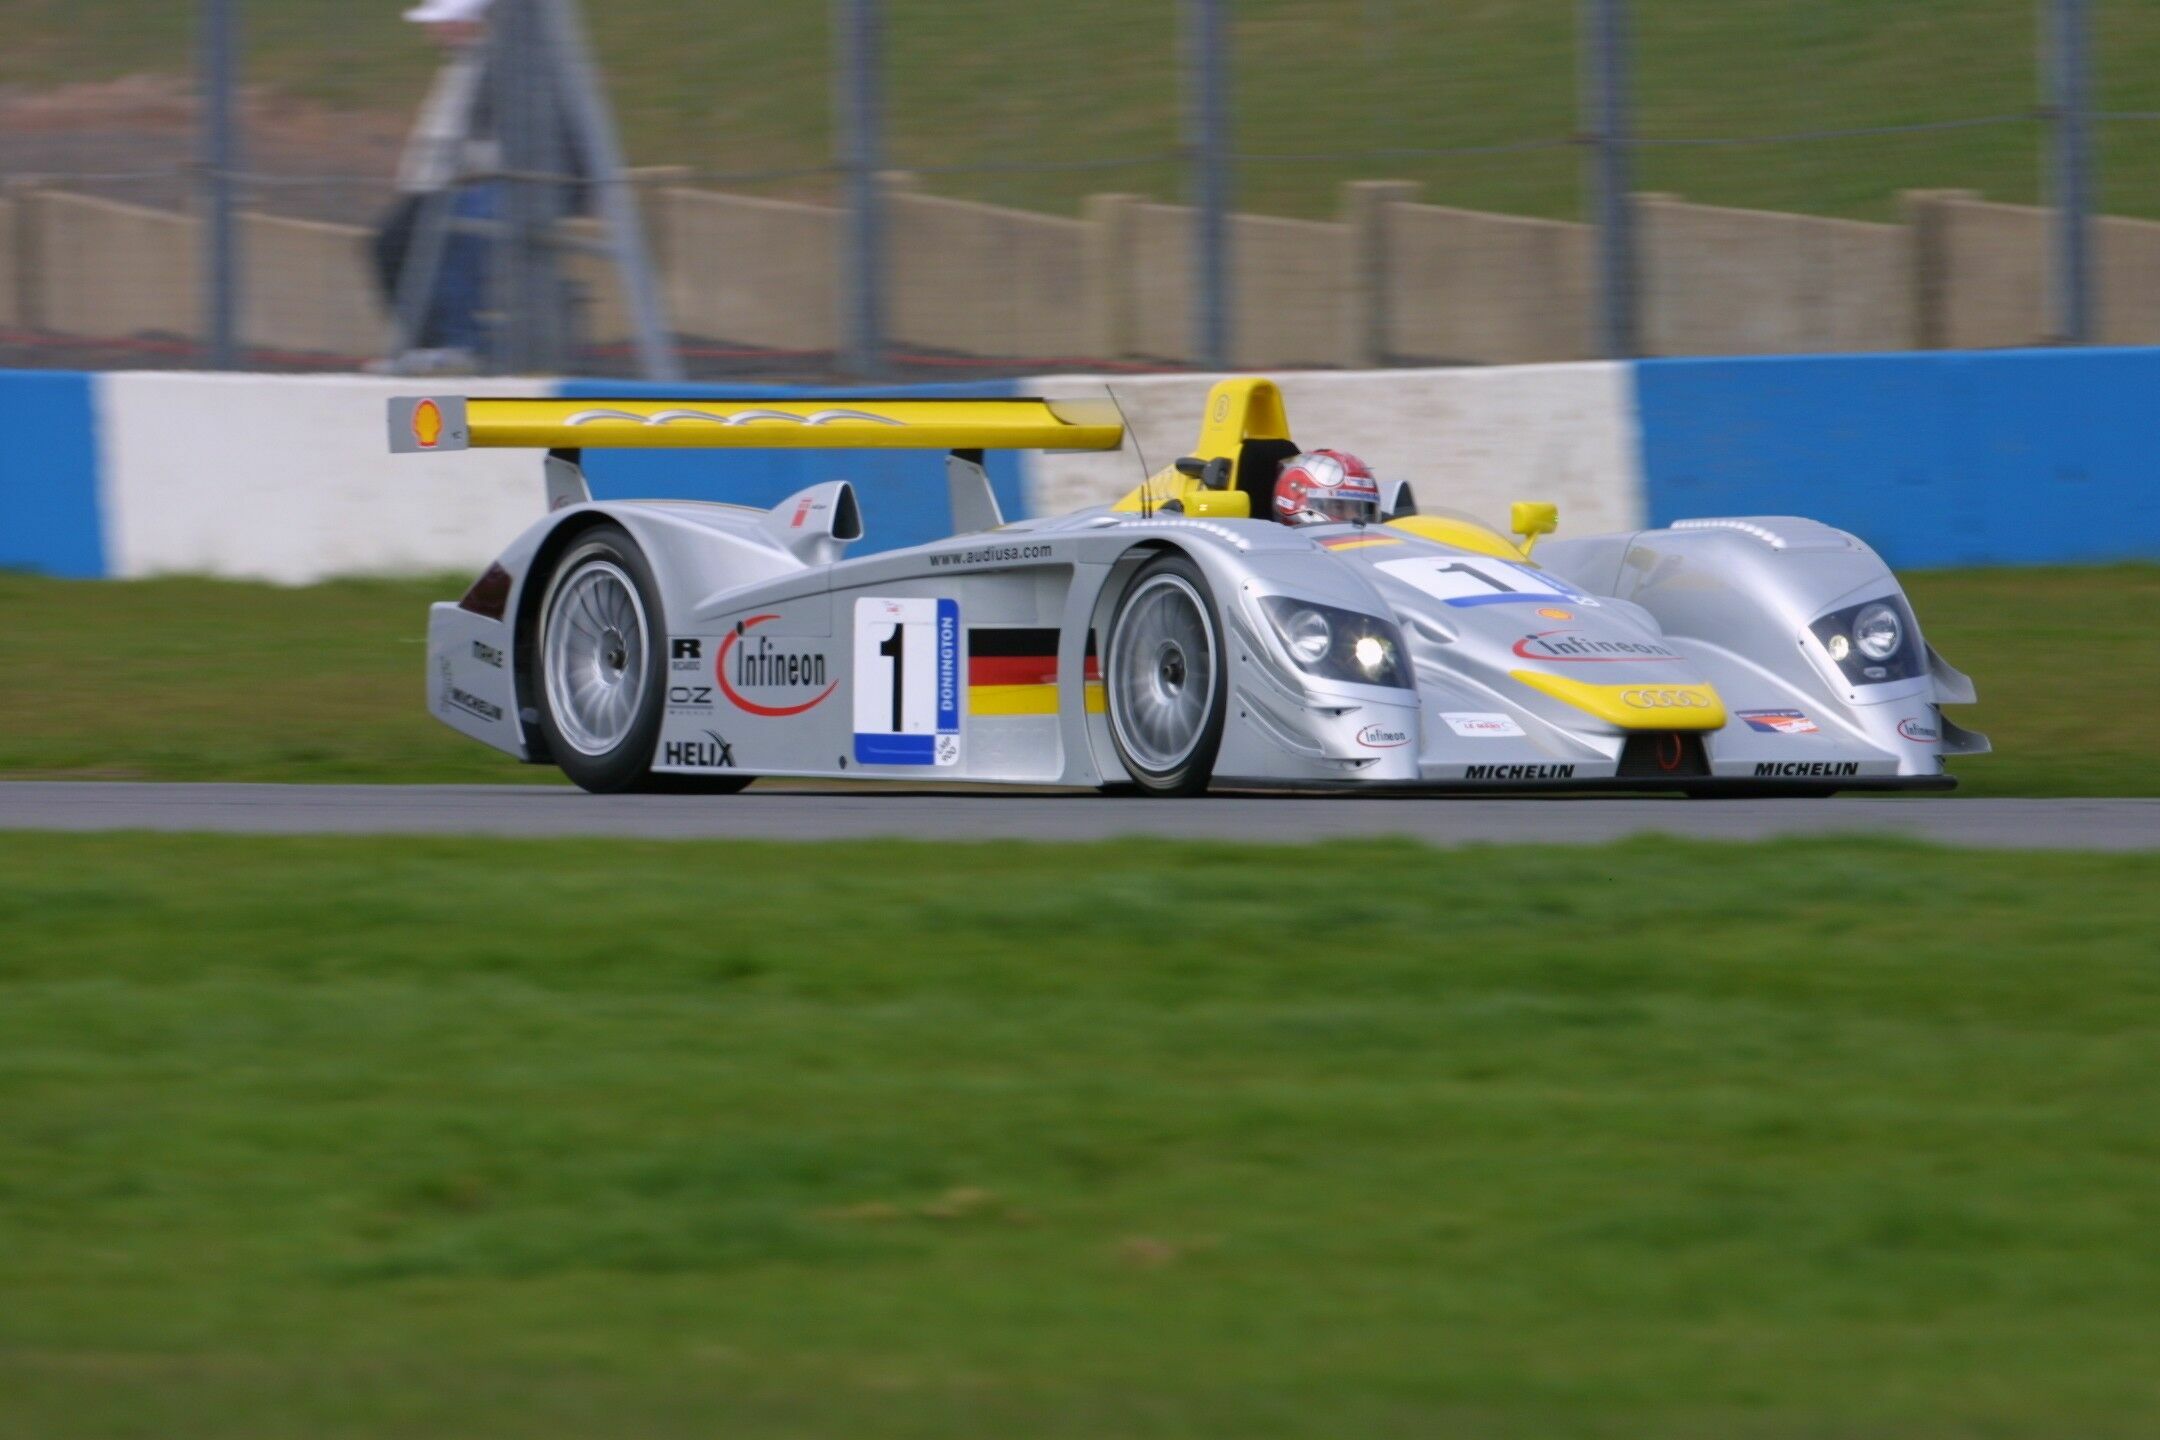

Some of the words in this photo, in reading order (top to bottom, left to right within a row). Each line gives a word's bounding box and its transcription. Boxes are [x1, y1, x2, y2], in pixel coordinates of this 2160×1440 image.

[929, 545, 1052, 566] www.audiusa.com
[1435, 562, 1517, 593] 1
[672, 638, 702, 659] R
[736, 620, 826, 687] Infineon
[1525, 634, 1674, 656] Infineon
[940, 616, 954, 711] DONINGTON
[880, 622, 904, 733] 1
[665, 735, 736, 767] HELIX
[1465, 765, 1575, 779] MICHELIN
[1754, 762, 1859, 777] MICHELIN
